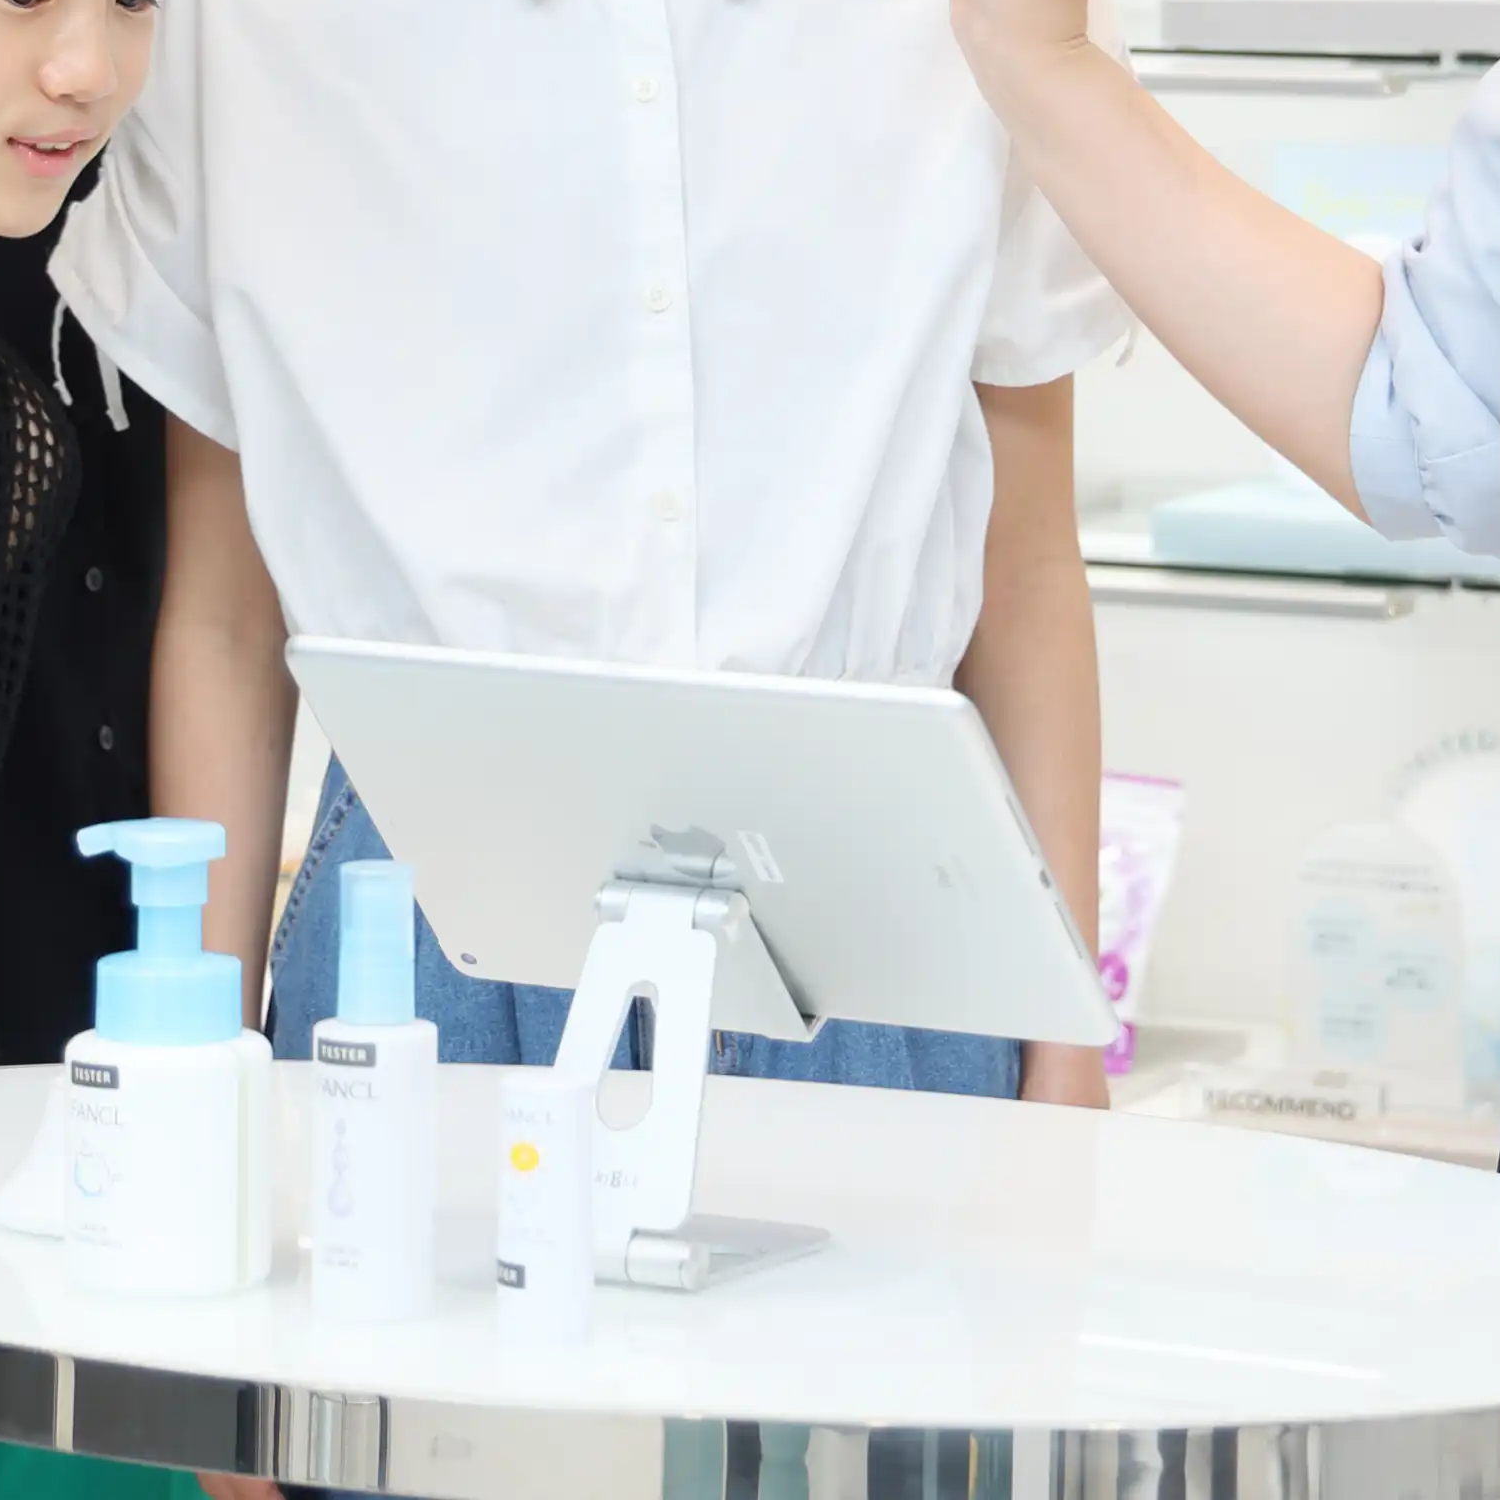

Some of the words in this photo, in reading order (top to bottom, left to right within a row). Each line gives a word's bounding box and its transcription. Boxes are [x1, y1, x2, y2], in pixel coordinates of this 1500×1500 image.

[321, 1044, 367, 1062] TESTER
[75, 1067, 112, 1084] TESTER
[316, 1077, 380, 1100] FANCL
[71, 1099, 126, 1126] FANCL
